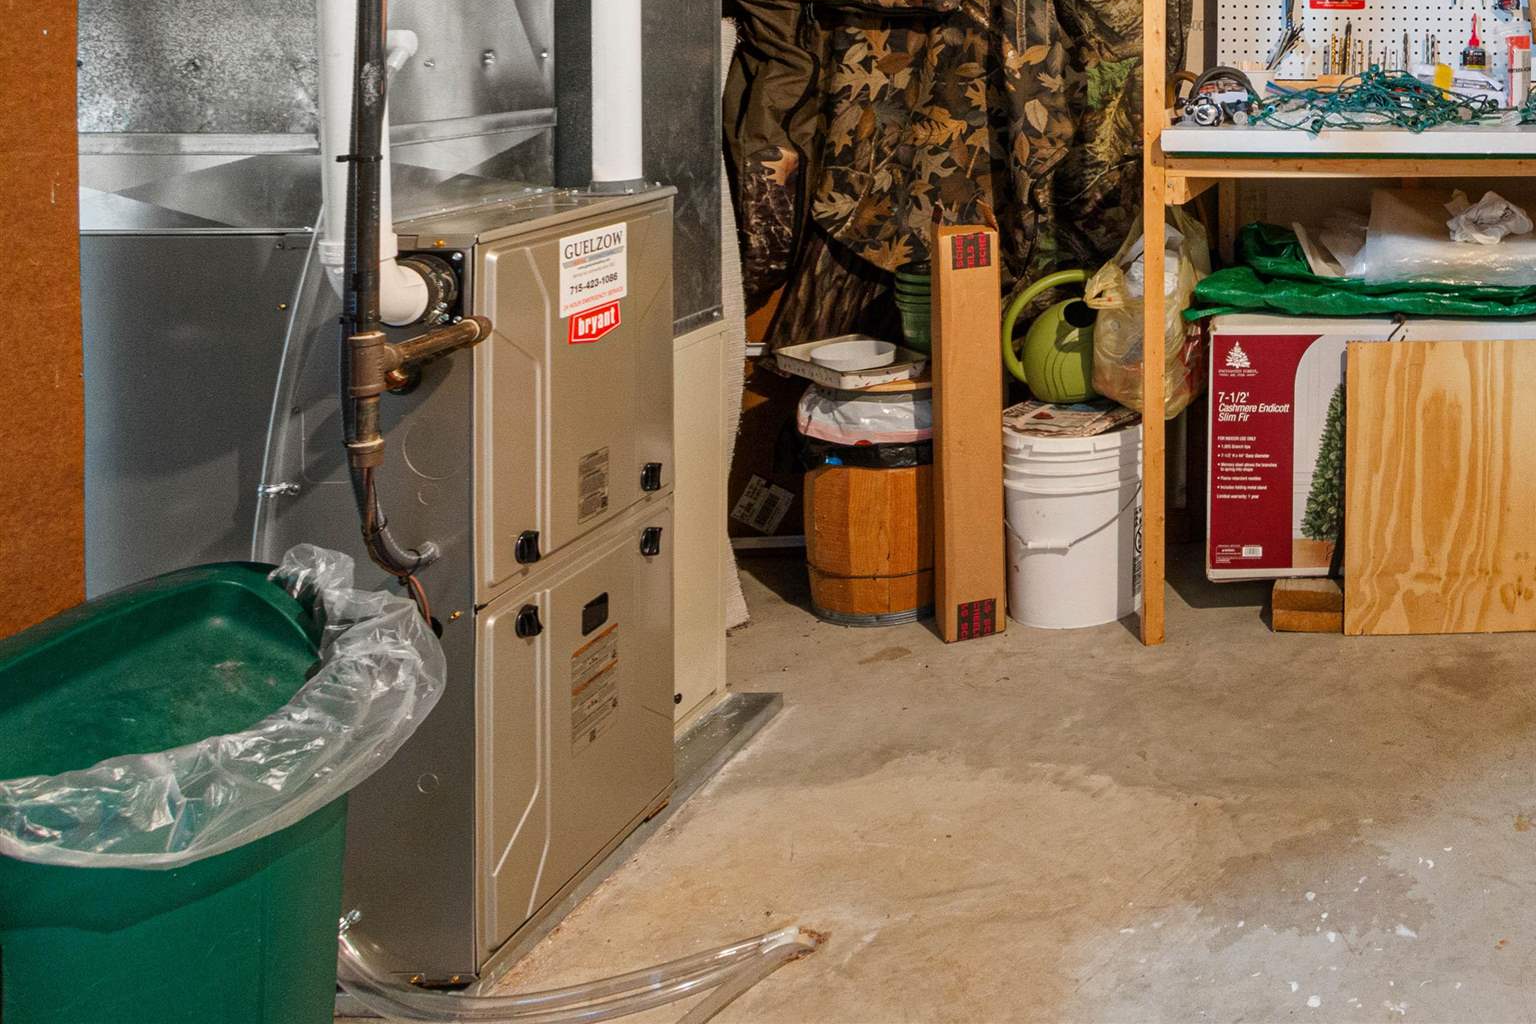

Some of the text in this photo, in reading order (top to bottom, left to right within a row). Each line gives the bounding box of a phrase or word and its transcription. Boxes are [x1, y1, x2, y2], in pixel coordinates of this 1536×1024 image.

[564, 230, 623, 259] GUELZOW
[569, 272, 618, 295] 715-423-1086
[578, 306, 615, 336] bryant
[1218, 391, 1250, 403] 7-1/2'
[1218, 403, 1290, 413] Cashmere Endicott
[1218, 412, 1250, 422] Slim Fir
